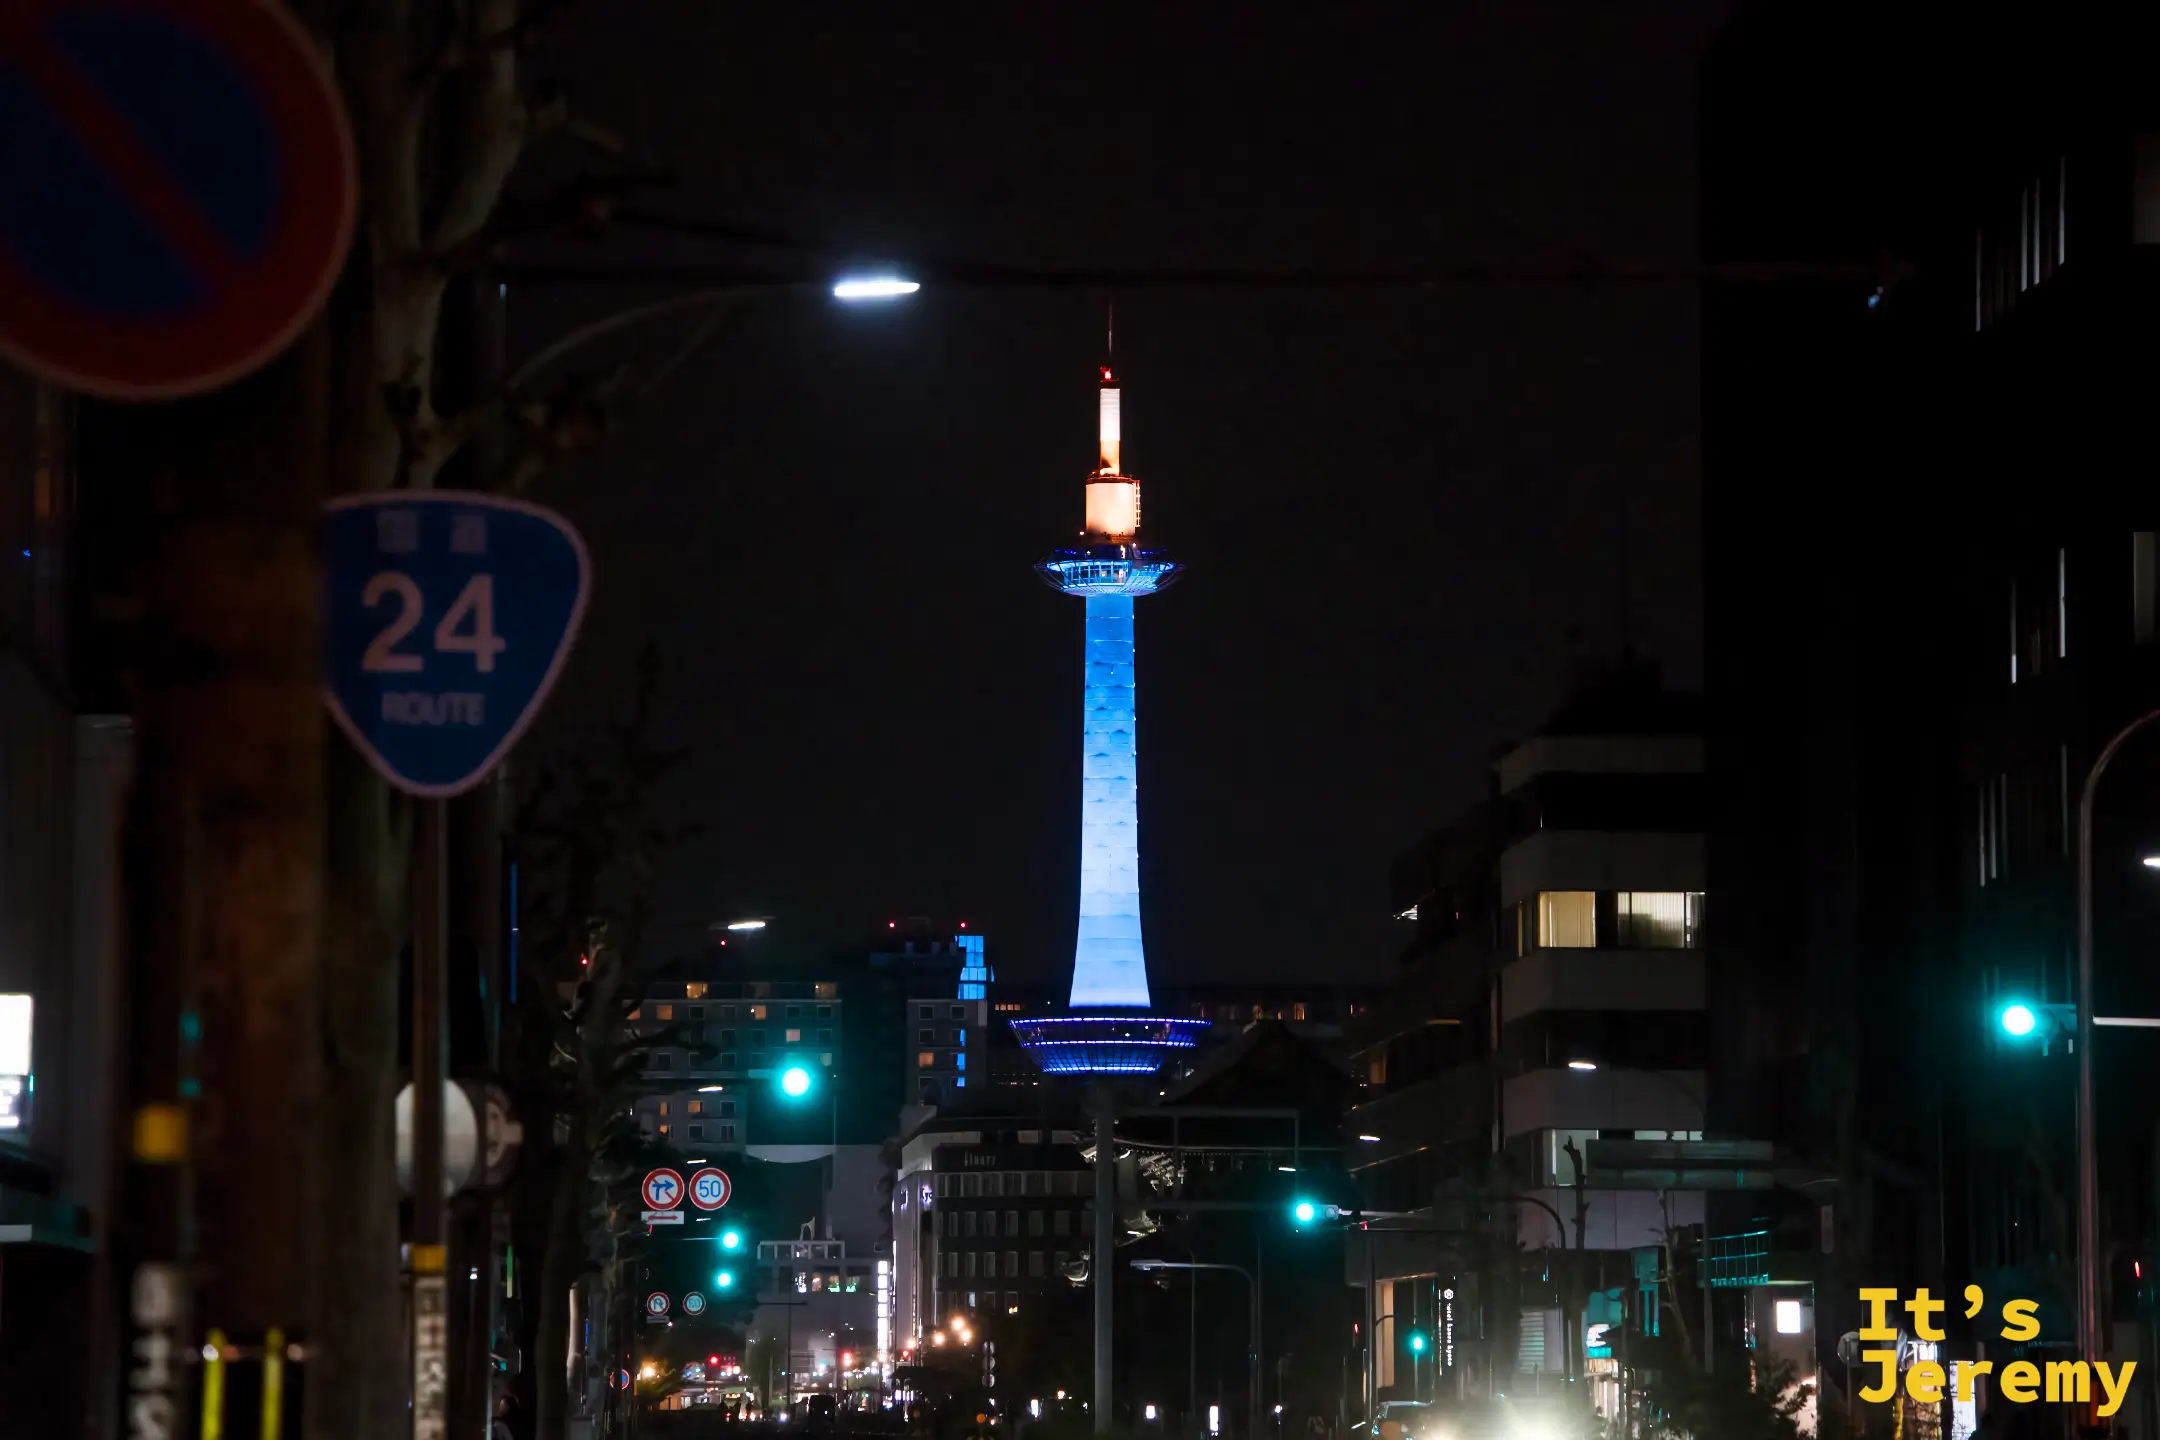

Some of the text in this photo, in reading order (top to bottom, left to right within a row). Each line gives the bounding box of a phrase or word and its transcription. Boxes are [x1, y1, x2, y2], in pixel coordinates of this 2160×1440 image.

[360, 568, 508, 674] 24
[380, 690, 486, 727] ROUTE
[699, 1180, 721, 1198] 50
